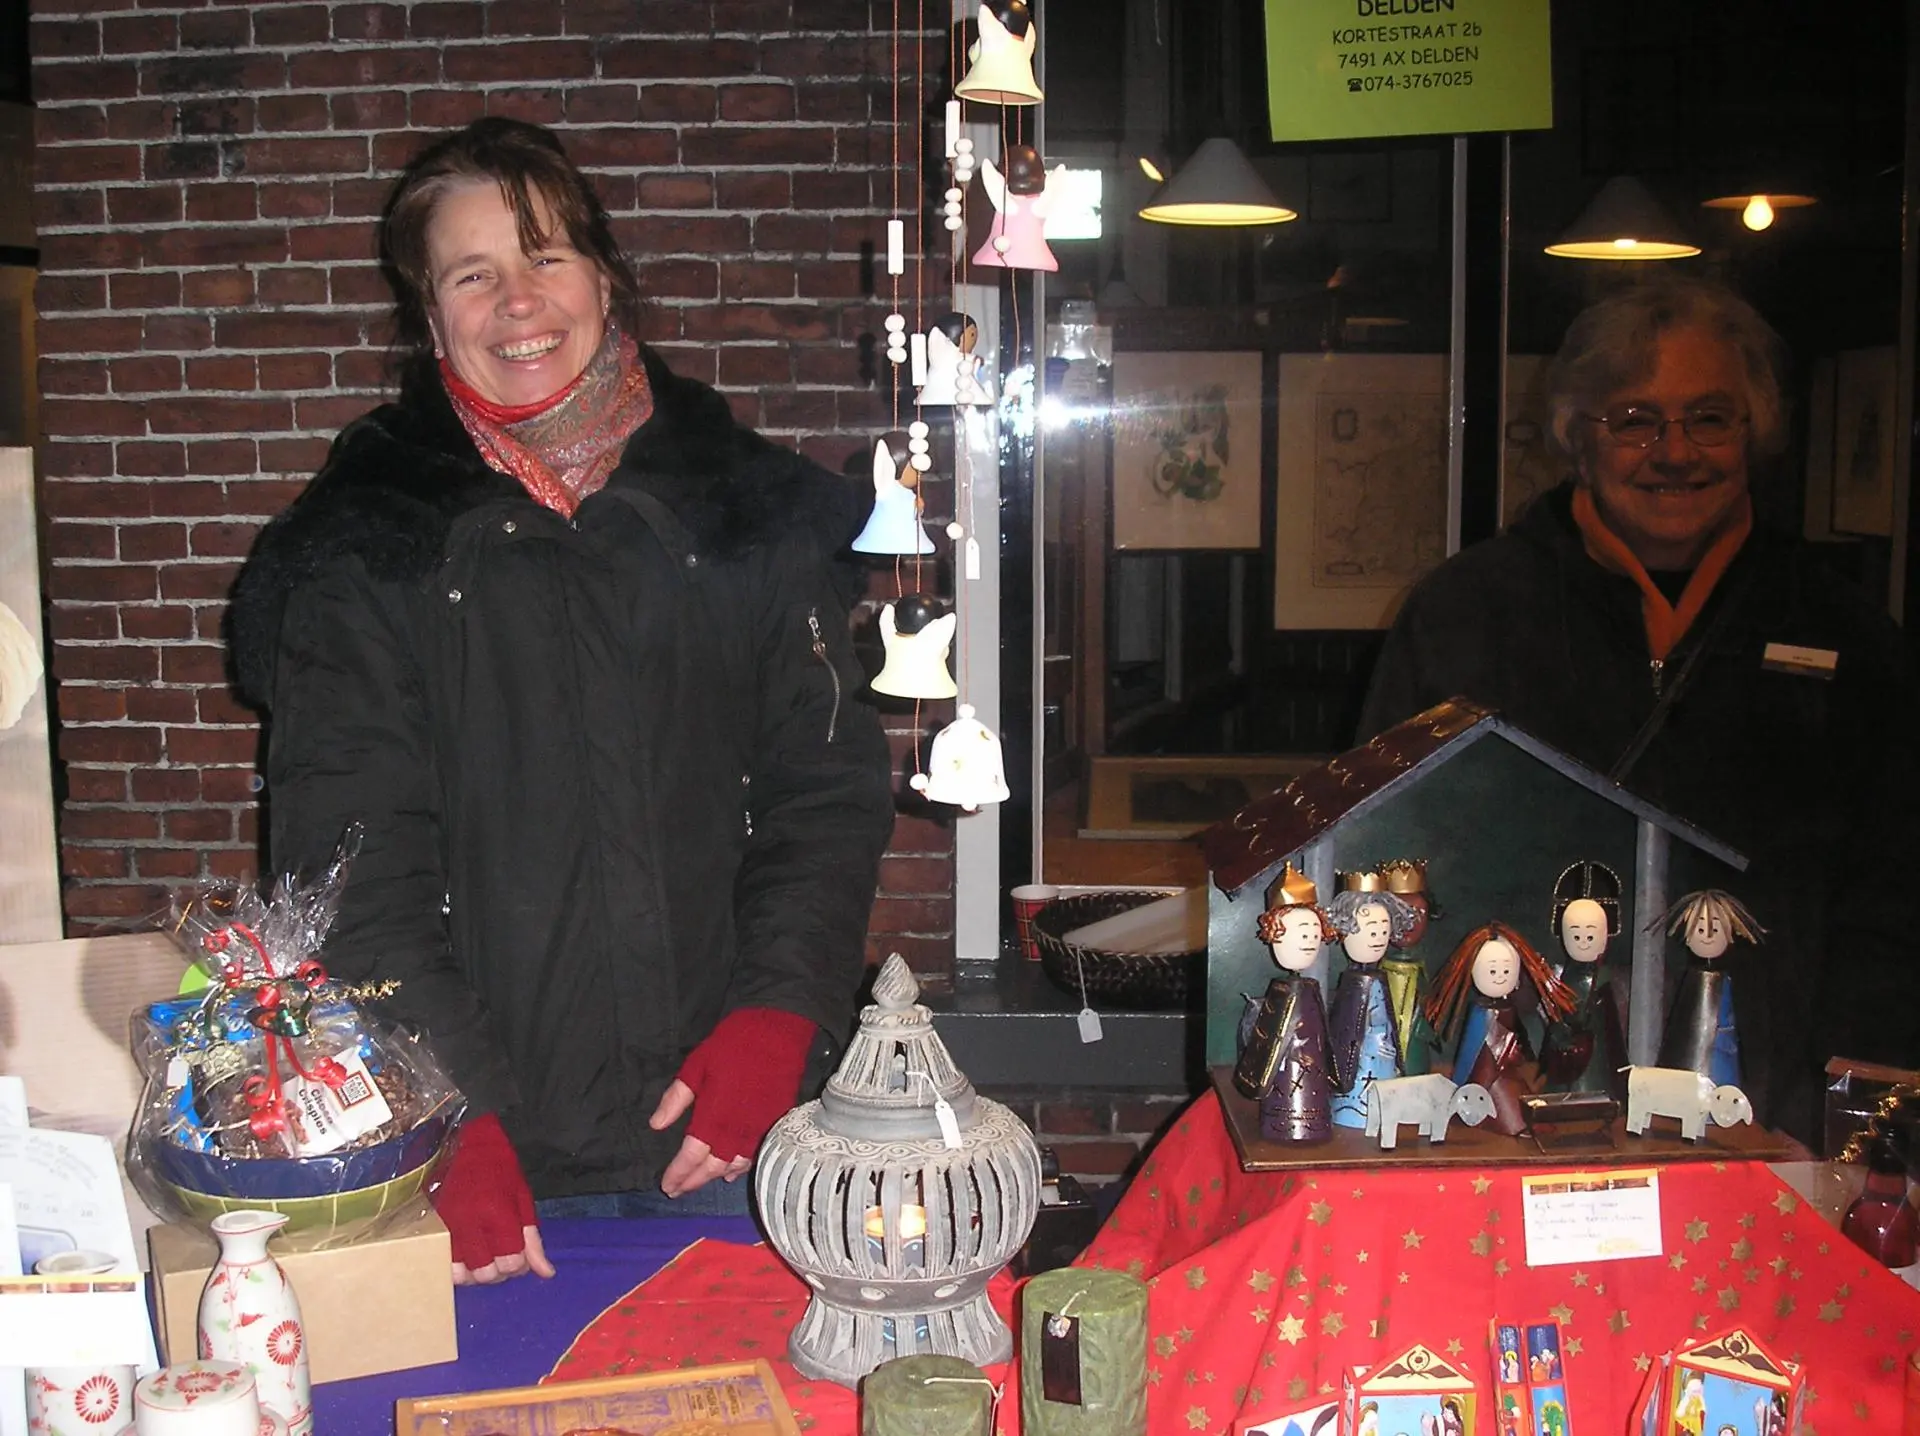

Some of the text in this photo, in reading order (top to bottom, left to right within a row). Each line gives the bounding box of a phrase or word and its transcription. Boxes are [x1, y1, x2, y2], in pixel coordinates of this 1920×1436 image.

[1357, 0, 1455, 17] DELDEN
[1332, 21, 1482, 45] KORTESTRAAT 2b
[1338, 46, 1479, 69] 7491 AX DELDEN
[1364, 71, 1473, 92] 074-3767025
